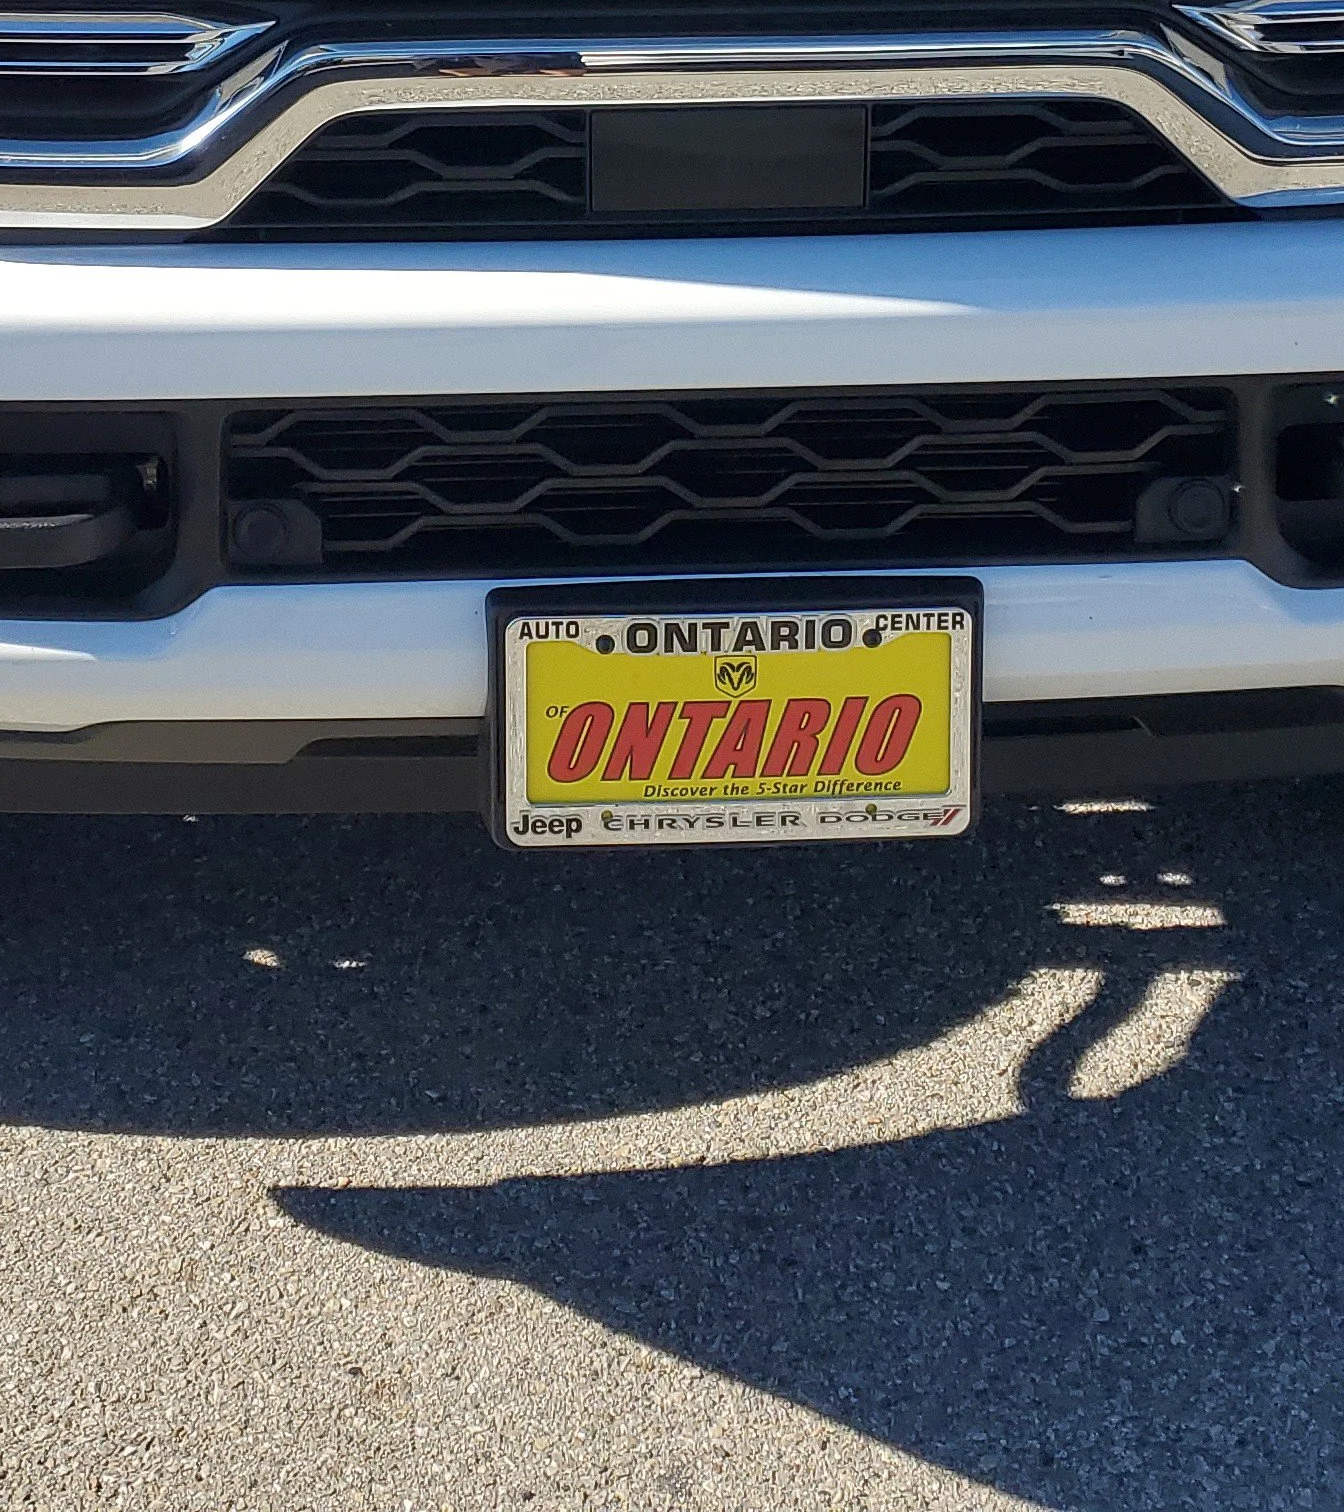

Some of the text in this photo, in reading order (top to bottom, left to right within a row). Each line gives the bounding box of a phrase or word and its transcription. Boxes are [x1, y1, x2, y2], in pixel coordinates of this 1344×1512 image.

[519, 612, 965, 654] AUTO ONTARIO CENTER
[545, 694, 922, 783] OF ONTARIO
[643, 779, 902, 798] Discover the 5-Star Difference
[513, 810, 945, 838] Jeep CHRYSLER DODGE
